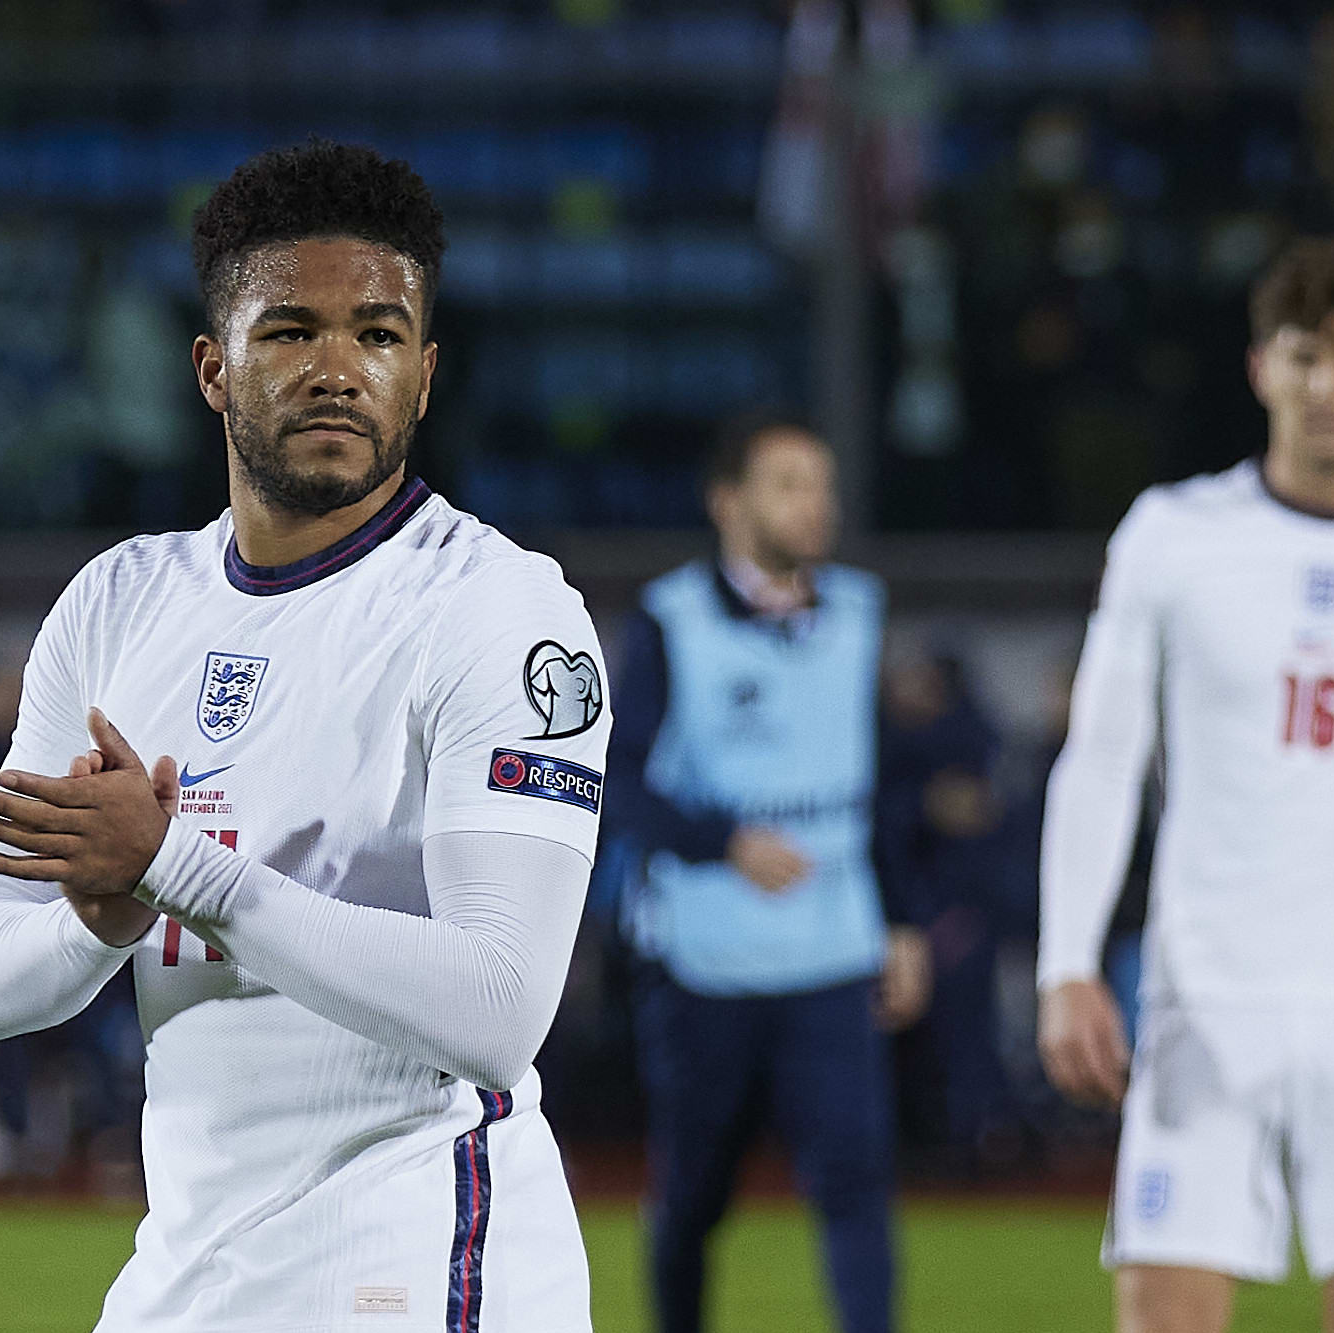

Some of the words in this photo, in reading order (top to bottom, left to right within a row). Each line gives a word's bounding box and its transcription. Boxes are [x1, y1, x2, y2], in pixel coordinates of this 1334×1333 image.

[528, 766, 601, 802] RESPECT
[181, 790, 197, 800] SAN
[180, 803, 216, 814] NOVEMBER
